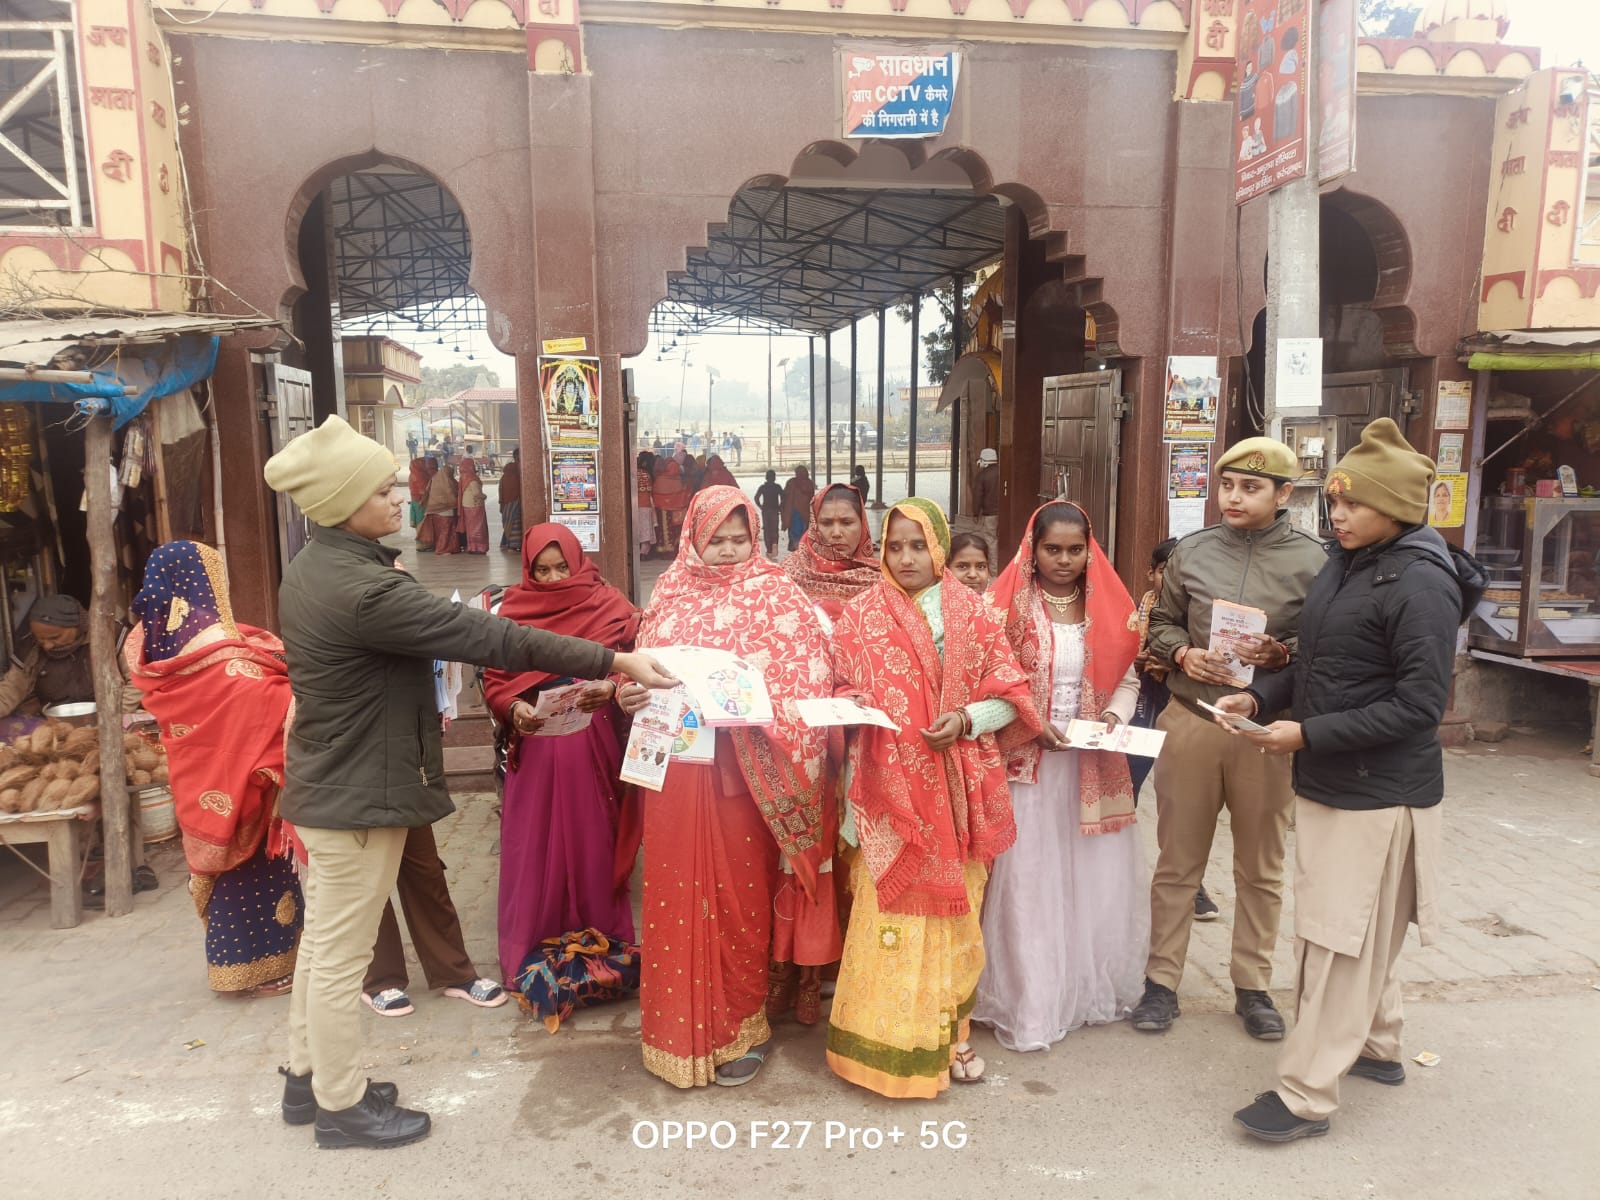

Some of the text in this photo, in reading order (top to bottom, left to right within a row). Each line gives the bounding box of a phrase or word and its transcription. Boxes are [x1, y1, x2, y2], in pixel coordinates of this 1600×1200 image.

[87, 25, 128, 48] जय
[1206, 19, 1229, 51] दी
[876, 54, 949, 77] सावधान
[89, 86, 136, 111] माता
[852, 84, 948, 103] आप CCTV कैमरे
[861, 107, 939, 127] की निगरानी में है
[102, 149, 134, 183] दी
[1501, 155, 1526, 177] माता
[1548, 150, 1578, 169] माता
[1497, 206, 1518, 234] दी
[1547, 200, 1571, 227] दी
